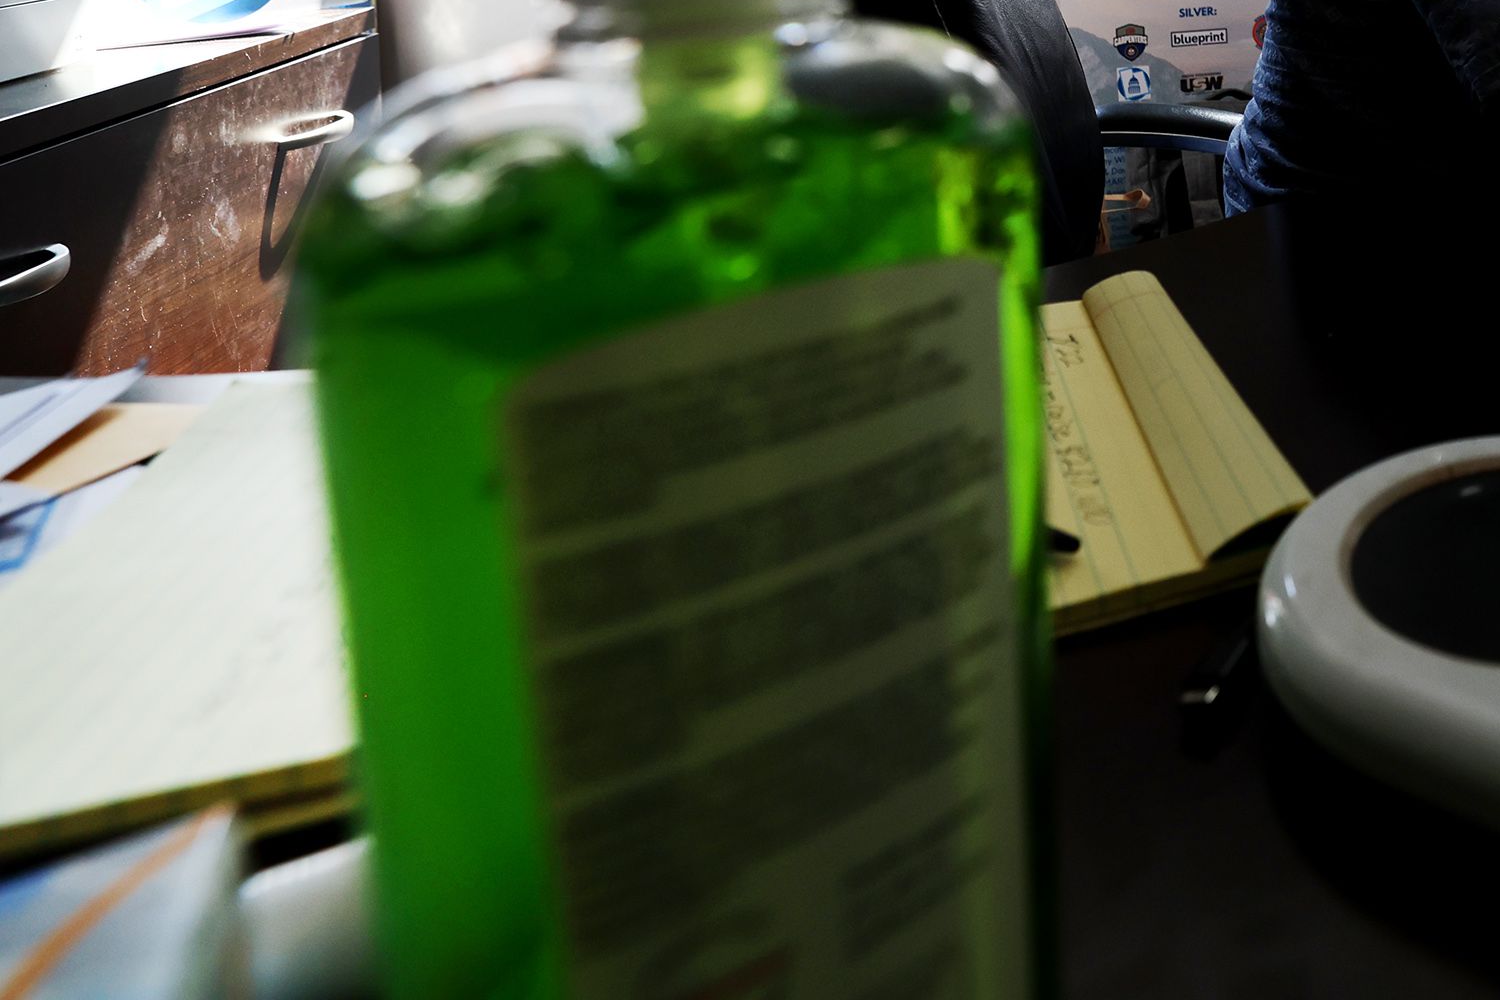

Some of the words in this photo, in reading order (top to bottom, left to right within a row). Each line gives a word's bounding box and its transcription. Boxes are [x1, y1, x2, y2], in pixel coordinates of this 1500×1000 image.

[1178, 7, 1218, 18] SILVER:
[1173, 32, 1225, 46] blueprint
[1181, 75, 1224, 93] USW
